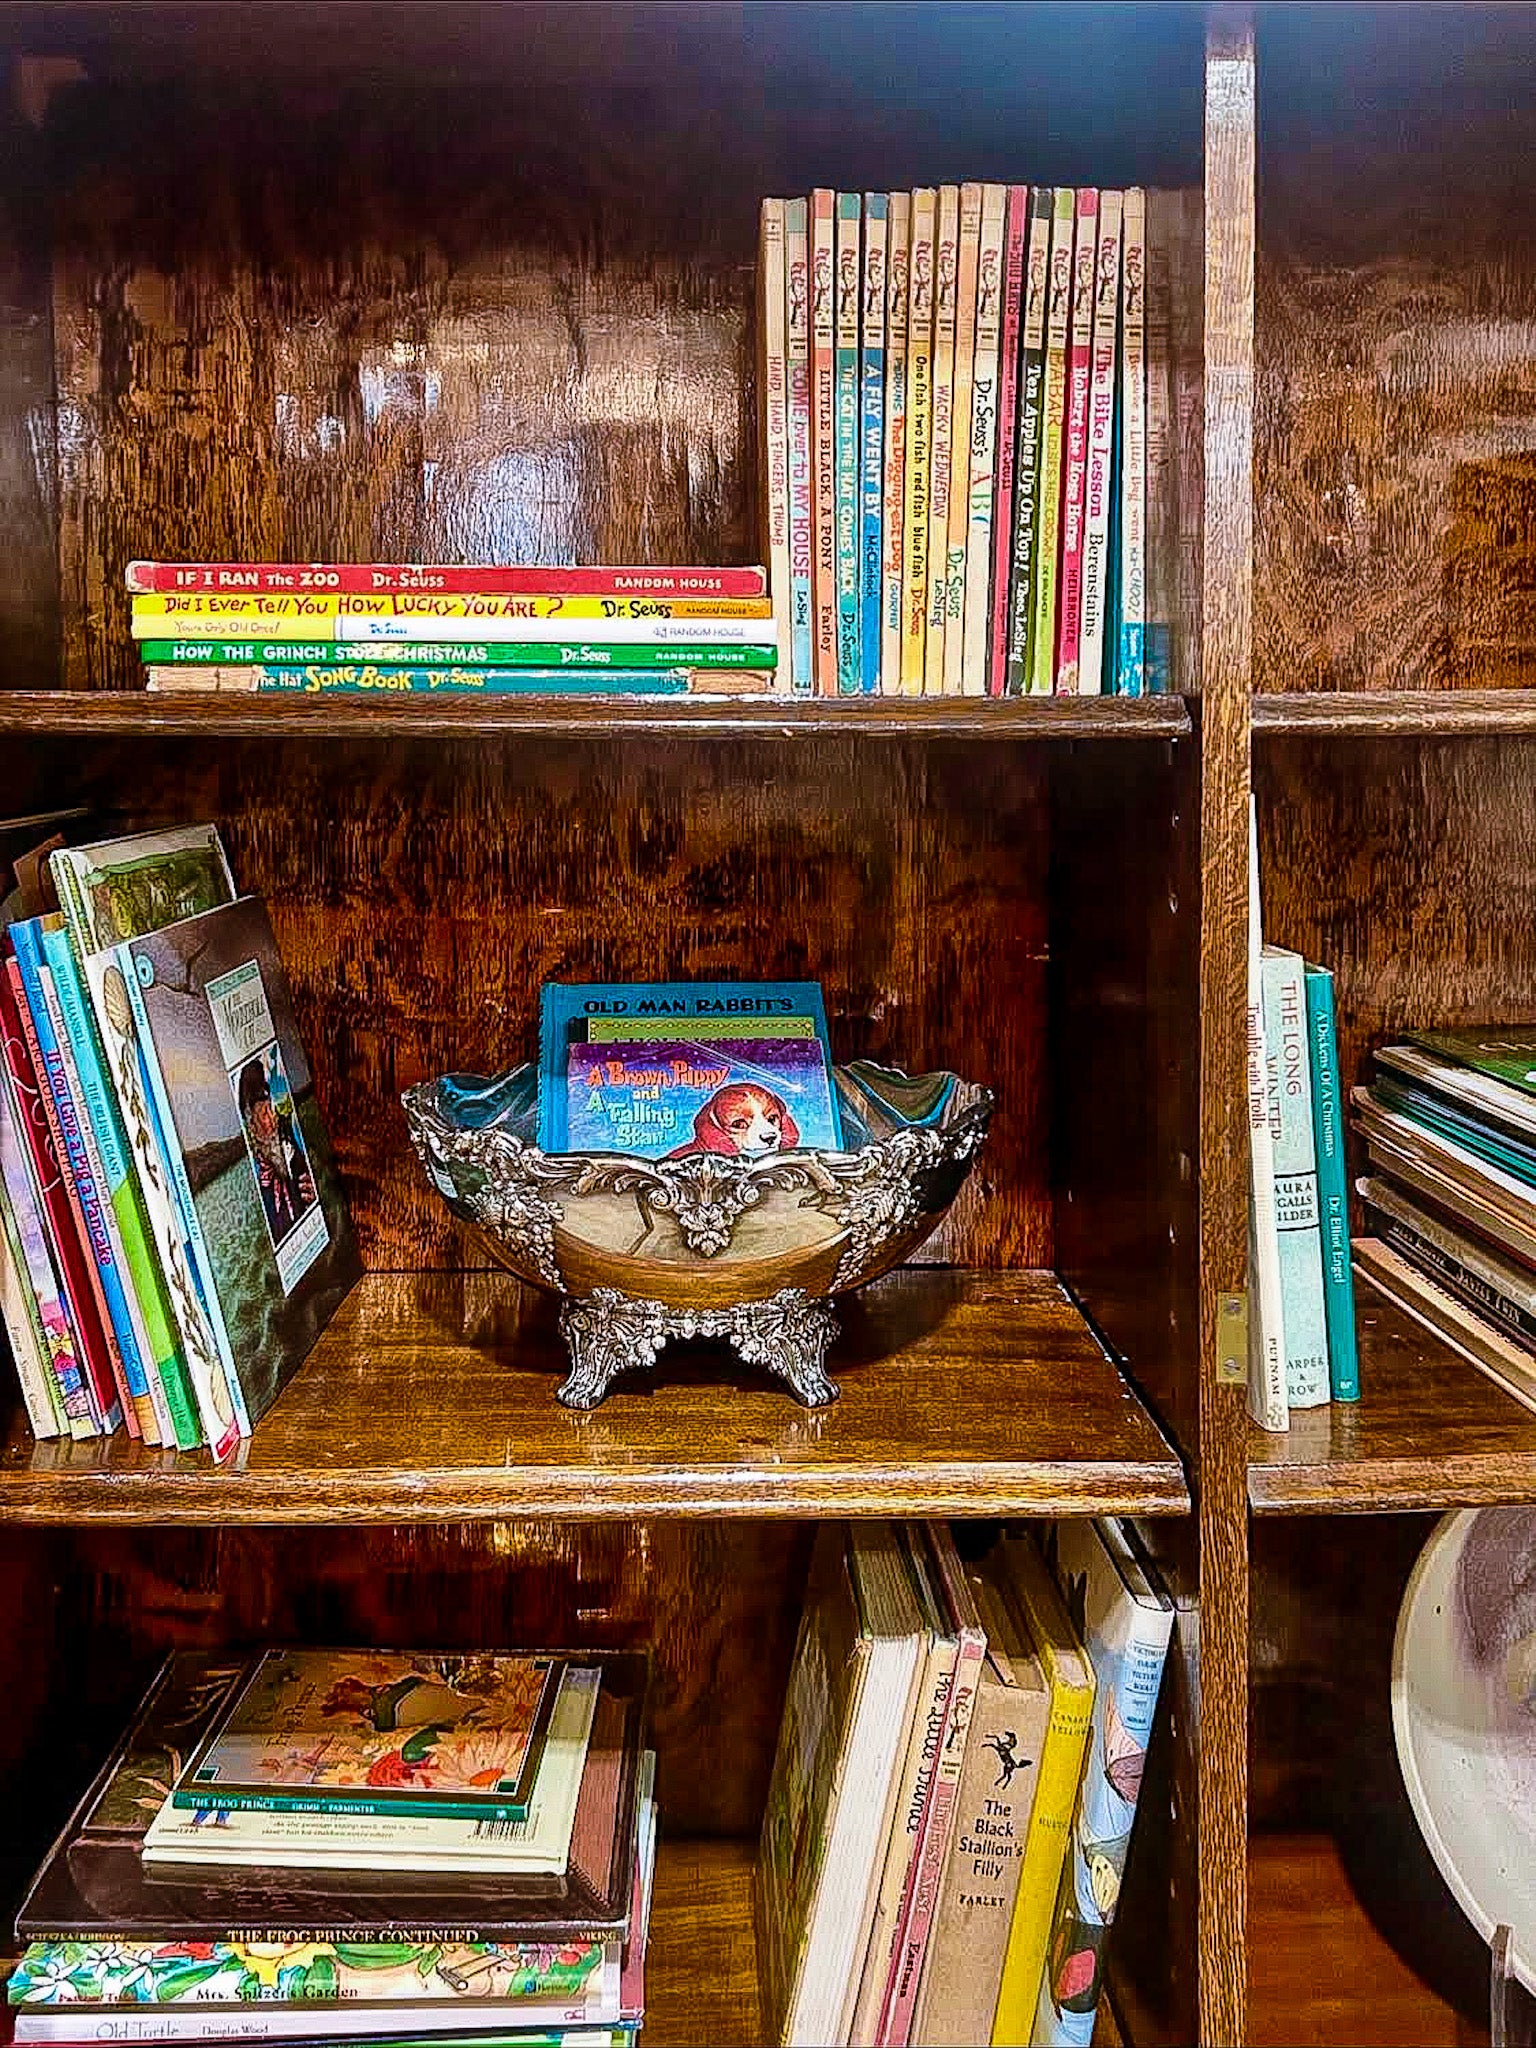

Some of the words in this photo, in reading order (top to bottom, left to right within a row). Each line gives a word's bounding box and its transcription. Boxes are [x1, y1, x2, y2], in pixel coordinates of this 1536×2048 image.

[842, 366, 855, 392] THE
[866, 364, 880, 378] A
[916, 356, 928, 379] One
[1095, 346, 1112, 384] The
[792, 367, 808, 417] COME
[915, 384, 928, 406] fish
[974, 379, 992, 403] Dr.
[1026, 364, 1041, 398] Ten
[1048, 349, 1063, 427] BABAR
[820, 369, 831, 431] LITTLE
[842, 394, 855, 420] CAT
[866, 386, 881, 419] FLY
[936, 385, 950, 433] WACKY
[1071, 366, 1087, 427] Robert
[893, 416, 905, 444] The
[915, 414, 926, 436] two
[1094, 393, 1110, 439] Bike
[793, 422, 807, 459] over
[842, 423, 855, 441] IN
[1021, 403, 1038, 466] Apples
[1070, 432, 1084, 457] the
[842, 442, 855, 467] THE
[866, 427, 880, 488] WENT
[914, 441, 927, 464] fish
[794, 463, 808, 478] to
[819, 439, 831, 500] BLACK,
[914, 472, 926, 491] red
[933, 441, 949, 518] WEDNESDAY
[1020, 470, 1034, 494] Up
[1067, 461, 1084, 501] Rose
[1090, 446, 1108, 518] Lesson
[794, 484, 809, 511] MY
[841, 472, 855, 499] HAT
[820, 506, 831, 517] A
[865, 492, 879, 517] BY
[913, 495, 926, 518] fish
[1020, 498, 1034, 524] On
[772, 503, 784, 546] THUMB
[841, 504, 854, 553] COMES
[1067, 504, 1082, 552] Horse
[794, 518, 809, 578] HOUSE
[821, 525, 832, 572] PONY
[913, 527, 925, 551] blue
[1014, 526, 1033, 571] Top!
[866, 535, 878, 598] McClintock
[885, 540, 902, 572] Dog
[912, 555, 924, 578] fish
[176, 571, 197, 585] IF
[204, 571, 214, 585] I
[219, 571, 259, 585] RAN
[300, 572, 340, 587] ZOO
[372, 572, 397, 587] Dr.
[400, 572, 445, 588] Seuss
[614, 577, 674, 588] RANDOM
[840, 557, 854, 597] BACK
[1085, 533, 1104, 637] Berenstains
[165, 597, 191, 613] Did
[195, 598, 202, 612] I
[209, 598, 250, 612] Ever
[254, 598, 290, 615] Tell
[294, 597, 328, 615] You
[601, 601, 626, 617] Dr.
[629, 600, 673, 618] Seuss
[946, 576, 963, 619] Seuss
[820, 605, 832, 653] Farley
[172, 646, 213, 660] HOW
[220, 646, 255, 660] THE
[262, 646, 328, 660] GRINCH
[655, 652, 703, 661] RANDOM
[708, 652, 746, 662] HOUSE
[842, 633, 856, 667] Seuss
[305, 665, 358, 692] SONG
[584, 999, 629, 1015] OLD
[637, 999, 687, 1014] MAN
[696, 998, 795, 1014] RABBIT'S
[1281, 980, 1298, 1026] THE
[1316, 1011, 1326, 1021] A
[1247, 1002, 1260, 1057] Trouble
[46, 1047, 60, 1064] If
[1316, 1023, 1331, 1068] Dickens
[587, 1065, 605, 1087] A
[606, 1061, 671, 1086] Brown
[670, 1060, 731, 1088] Puppy
[1248, 1061, 1260, 1085] with
[1282, 1034, 1302, 1096] LONG
[1320, 1070, 1332, 1085] Of
[51, 1068, 71, 1098] You
[87, 1081, 102, 1102] THE
[633, 1087, 660, 1101] and
[1321, 1088, 1332, 1098] A
[58, 1100, 80, 1138] Give
[587, 1091, 606, 1112] A
[609, 1102, 677, 1129] Falling
[1250, 1088, 1264, 1129] Trolls
[92, 1103, 114, 1143] SELFISH
[613, 1124, 667, 1147] Star
[1321, 1100, 1337, 1158] Christmas
[68, 1140, 81, 1151] a
[103, 1142, 123, 1177] GIANT
[72, 1153, 91, 1181] Pig
[80, 1184, 93, 1196] a
[174, 1163, 183, 1177] THE
[190, 1225, 200, 1240] CAT
[1328, 1195, 1340, 1214] Dr.
[85, 1196, 112, 1266] Pancake
[1328, 1216, 1343, 1247] Elliot
[1329, 1250, 1346, 1283] Engel
[1267, 1338, 1280, 1394] PUTNAM
[933, 1669, 953, 1703] The
[919, 1706, 944, 1761] Little
[191, 1797, 208, 1808] THE
[212, 1799, 238, 1809] FROG
[240, 1799, 275, 1810] PRINCE
[905, 1766, 932, 1835] Prince
[985, 1800, 1012, 1816] The
[975, 1818, 1014, 1837] Black
[959, 1836, 1023, 1857] Stallion's
[973, 1859, 1003, 1881] Filly
[227, 1930, 263, 1942] THE
[266, 1930, 311, 1943] FROG
[315, 1930, 375, 1943] PRINCE
[378, 1929, 479, 1943] CONTINUED
[580, 1931, 617, 1941] VIKING
[897, 1941, 920, 1998] Eastman
[196, 1988, 228, 2001] Mrs.
[303, 1985, 359, 2000] Garden
[96, 2021, 128, 2039] Old
[202, 2025, 239, 2036] Douglas
[241, 2024, 269, 2035] Wood
